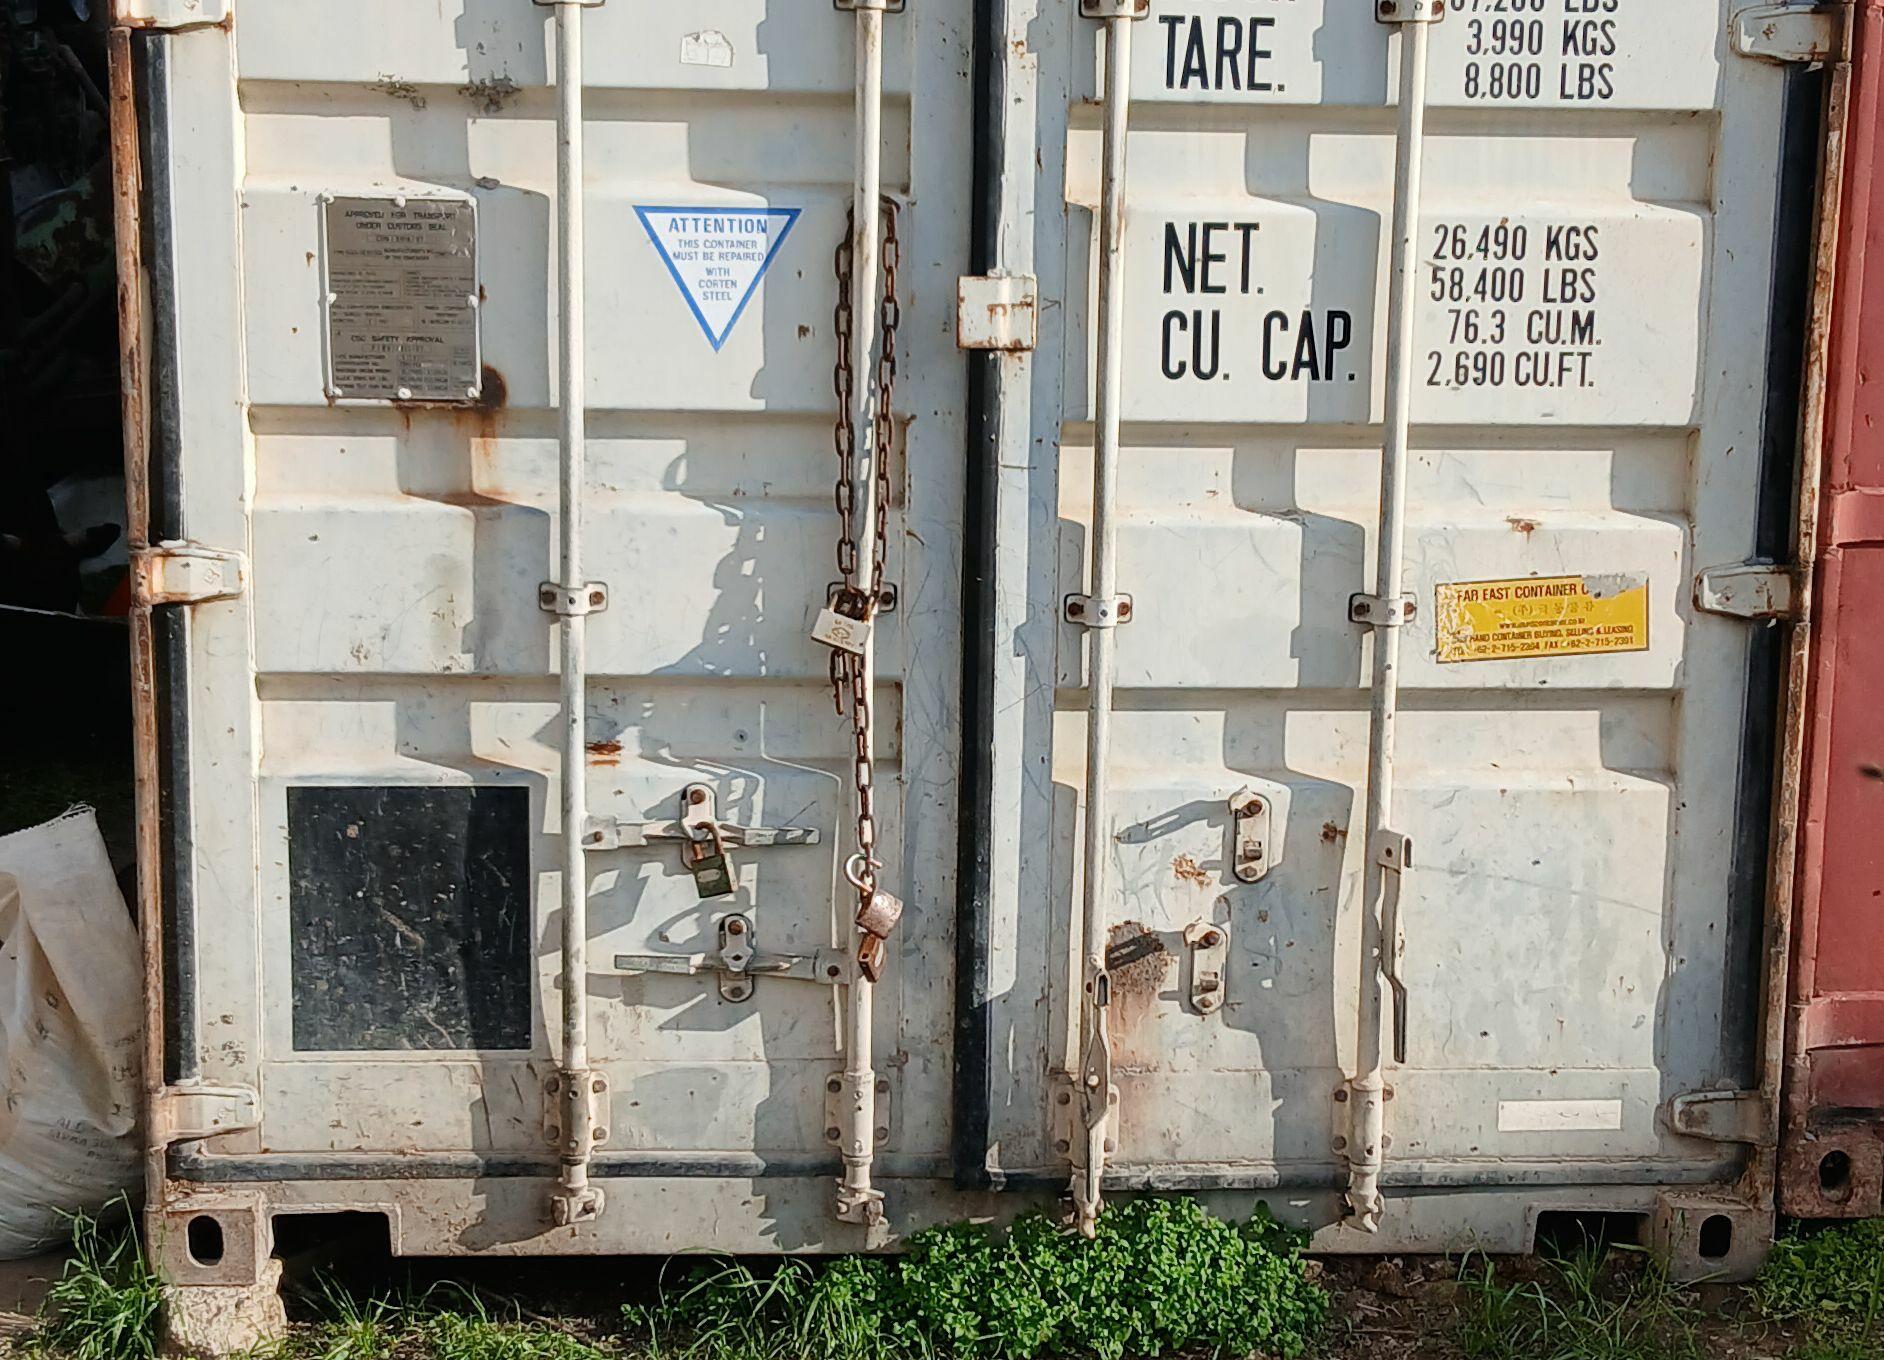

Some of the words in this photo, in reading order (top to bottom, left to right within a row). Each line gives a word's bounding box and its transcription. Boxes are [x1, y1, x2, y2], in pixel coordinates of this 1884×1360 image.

[1158, 15, 1286, 92] TARE.
[1466, 19, 1543, 56] 3,990
[1562, 19, 1616, 56] KGS
[1464, 62, 1541, 99] 8,800
[1560, 62, 1614, 100] LBS
[668, 217, 768, 234] ATTENTION
[678, 239, 700, 249] THIS
[703, 239, 758, 249] CONTAINER
[673, 251, 699, 261] MUST
[702, 252, 715, 261] BE
[718, 252, 764, 262] REPAIRED
[1163, 222, 1264, 294] NET.
[1433, 224, 1527, 261] 26,490
[1545, 225, 1599, 261] KGS
[705, 267, 730, 276] WITH
[698, 279, 737, 289] CORTEN
[1431, 267, 1524, 303] 58,400
[1543, 267, 1596, 303] LBS
[702, 291, 732, 301] STEEL
[1161, 309, 1230, 381] CU.
[1262, 309, 1356, 381] CAP.
[1448, 309, 1505, 344] 76.3
[1427, 350, 1505, 386] 2,690
[1457, 589, 1478, 602] FAR
[1482, 587, 1511, 601] EAST
[1514, 583, 1577, 599] CONTAINER
